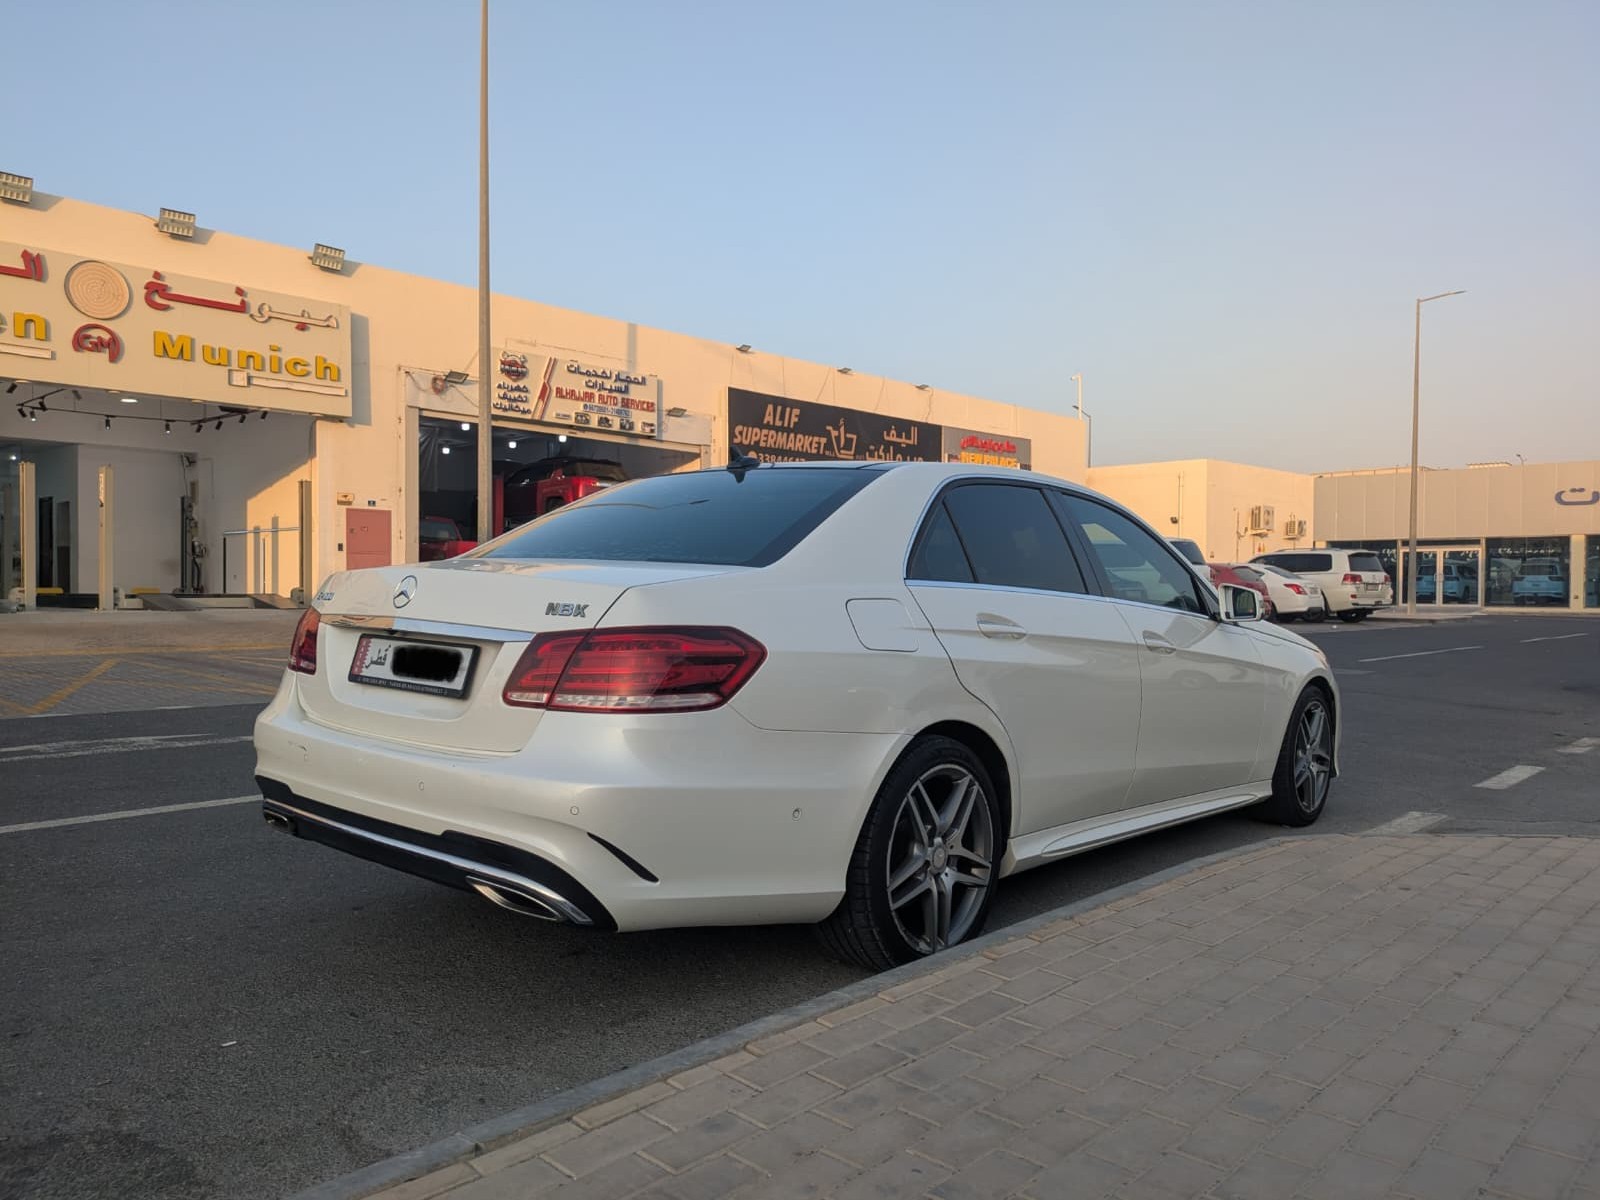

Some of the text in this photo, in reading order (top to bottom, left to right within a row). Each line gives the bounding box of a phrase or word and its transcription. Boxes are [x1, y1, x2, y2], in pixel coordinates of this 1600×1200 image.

[0, 311, 48, 341] n
[153, 330, 340, 382] Munich
[585, 379, 630, 394] السيارات
[555, 386, 595, 404] ALHAJJAR
[598, 393, 618, 407] AUTO
[620, 397, 655, 413] SERVICES
[763, 404, 801, 429] ALIF
[733, 425, 827, 455] SUPERMARKET
[883, 425, 918, 448] اليف
[545, 602, 590, 618] NBK
[365, 644, 392, 669] قطر
